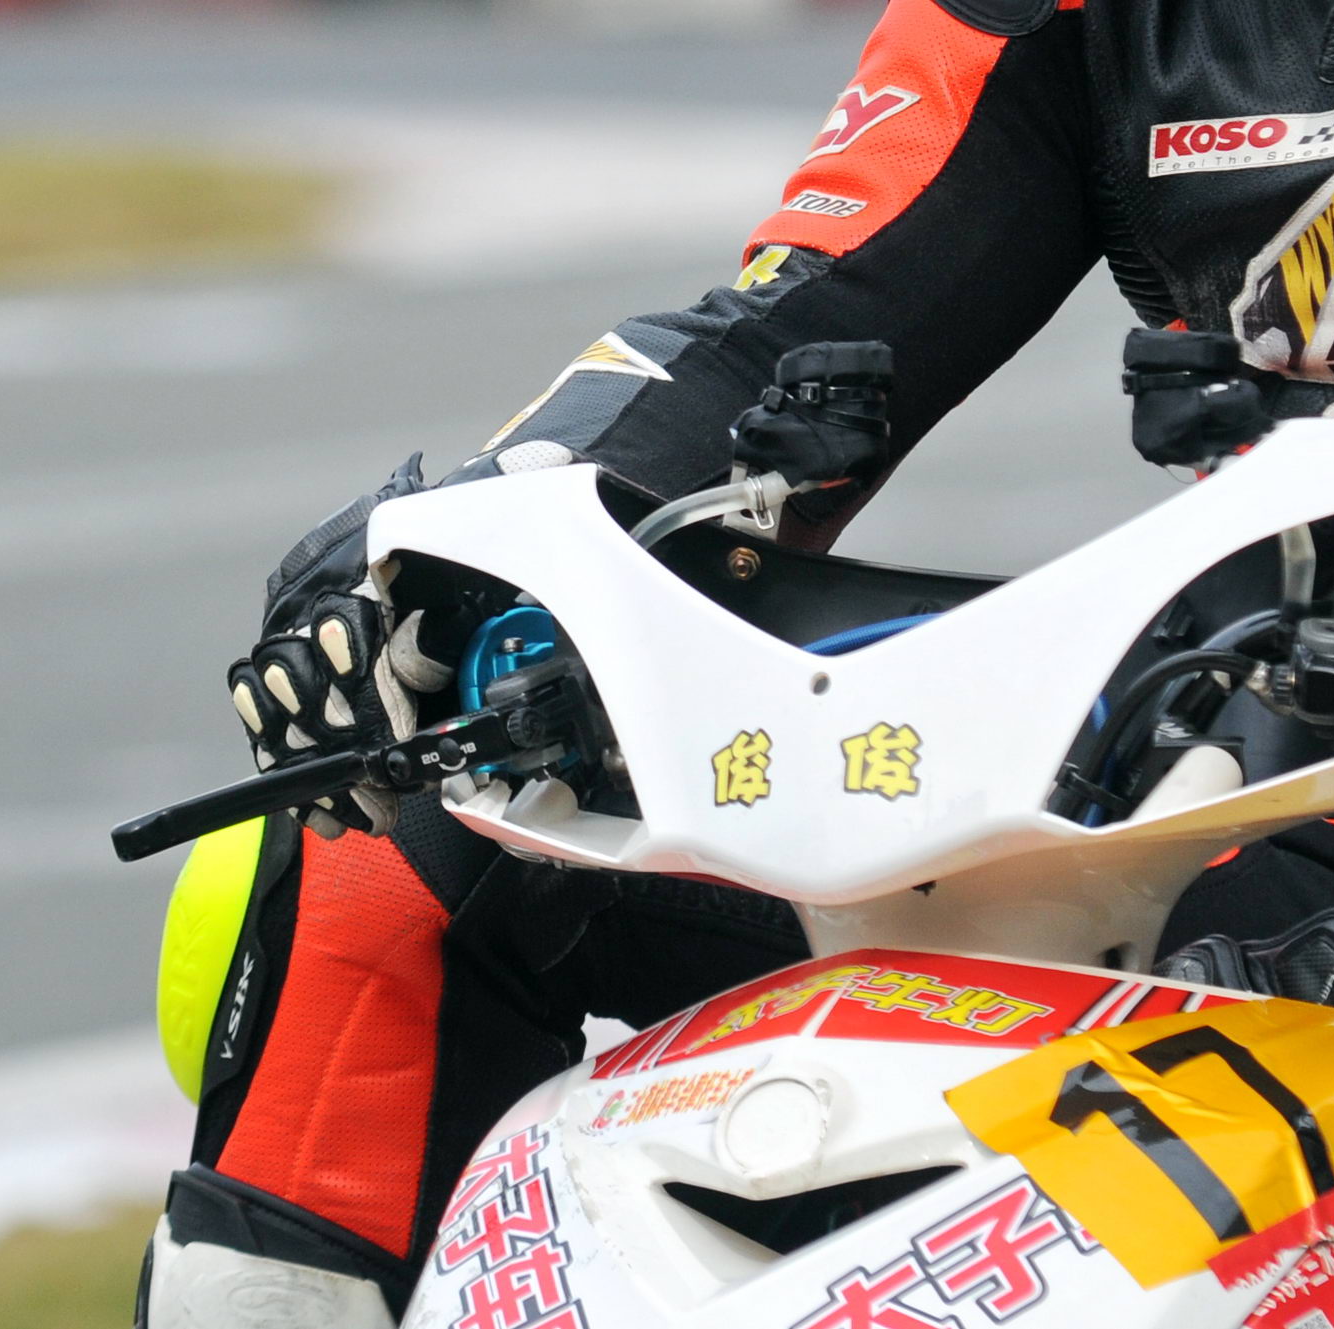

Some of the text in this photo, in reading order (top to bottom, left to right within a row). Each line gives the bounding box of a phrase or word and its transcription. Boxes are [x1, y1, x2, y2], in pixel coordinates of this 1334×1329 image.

[1154, 117, 1289, 160] KOSO
[1155, 158, 1206, 173] Feel
[1215, 154, 1252, 166] The
